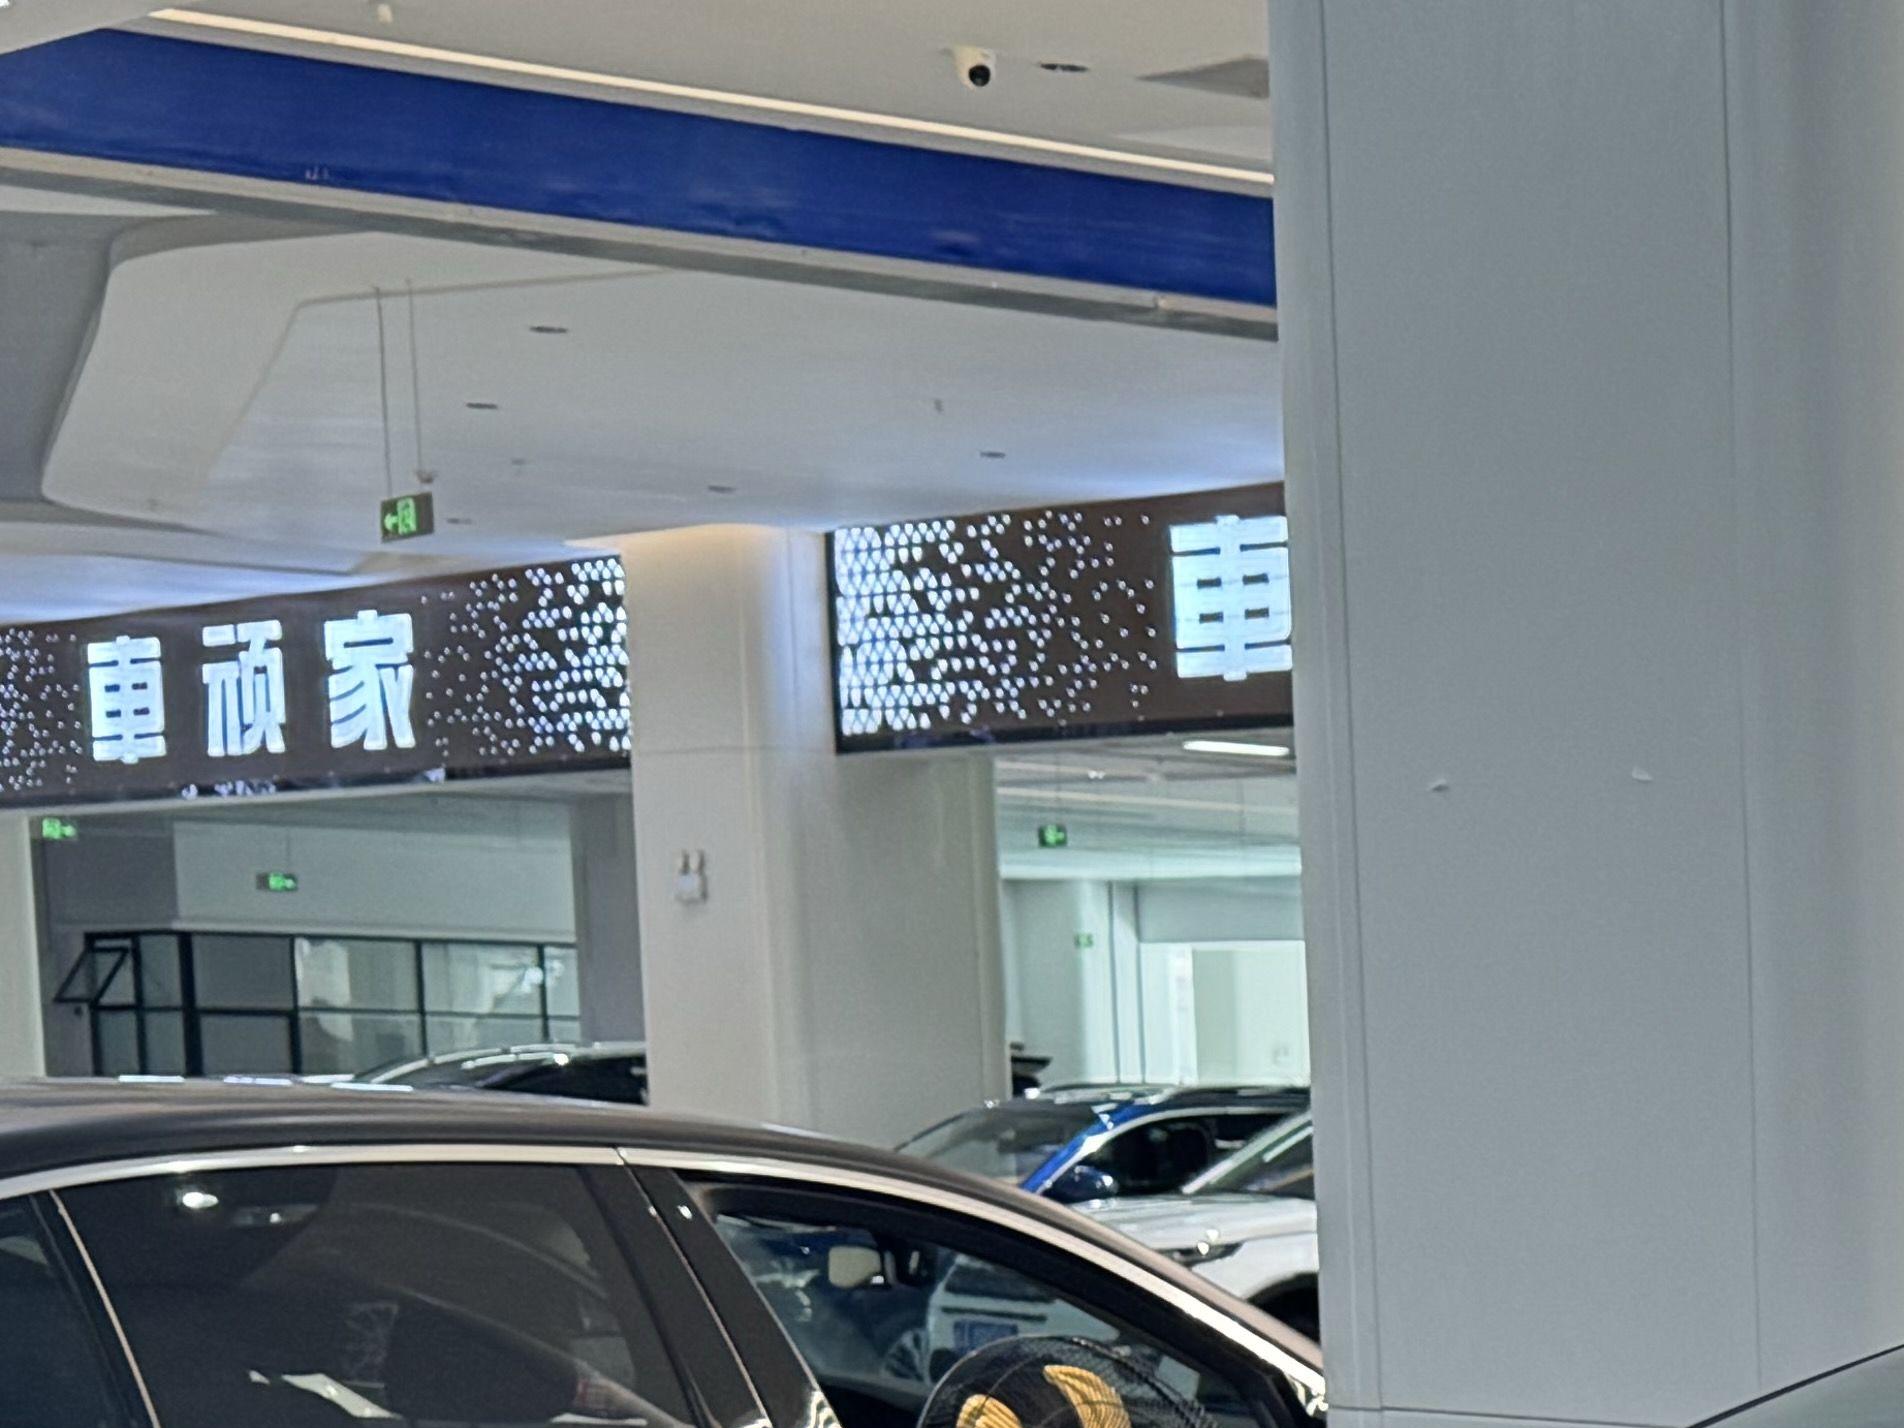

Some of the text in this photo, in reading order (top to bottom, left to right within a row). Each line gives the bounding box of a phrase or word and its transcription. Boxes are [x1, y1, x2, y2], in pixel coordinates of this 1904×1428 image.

[1169, 514, 1293, 681] 車
[86, 609, 416, 764] 車顽家
